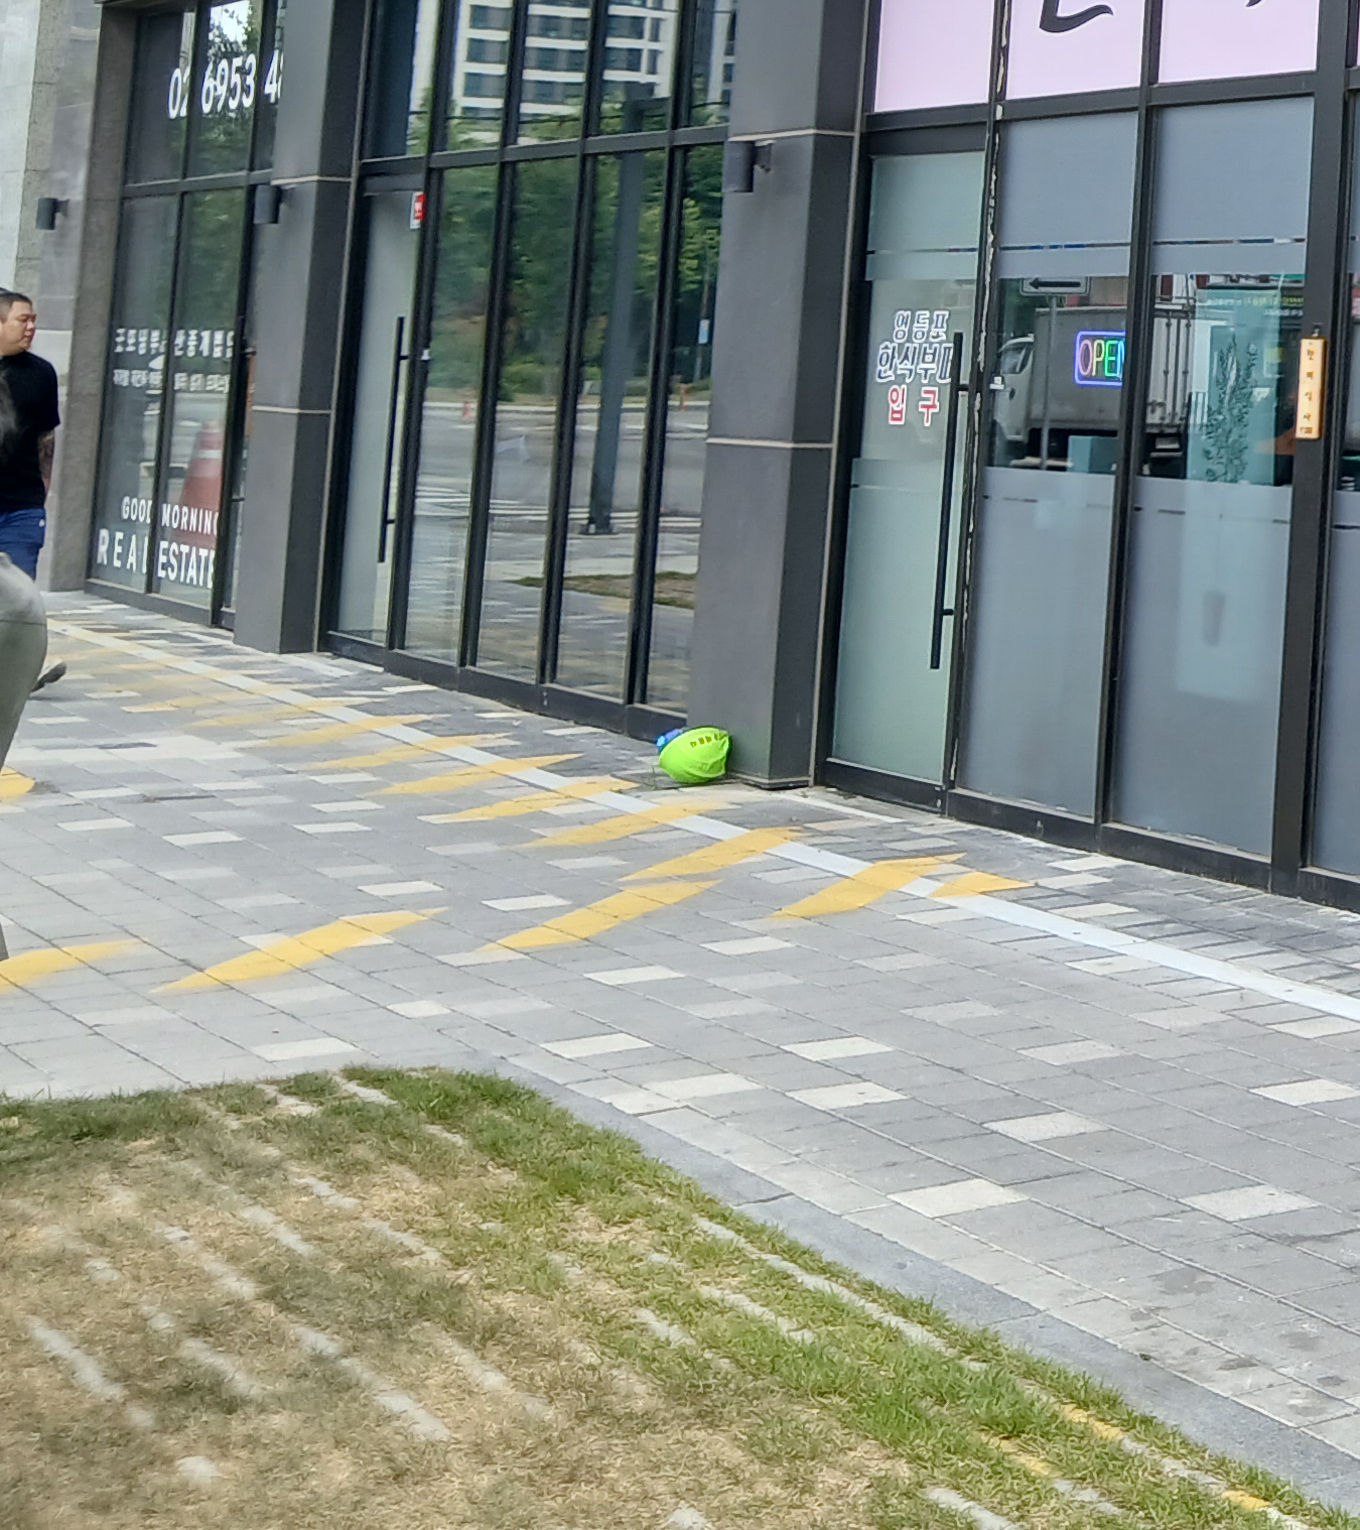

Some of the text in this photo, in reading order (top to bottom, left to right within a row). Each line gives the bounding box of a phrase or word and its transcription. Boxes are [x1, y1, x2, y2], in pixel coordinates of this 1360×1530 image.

[201, 53, 256, 114] 6953
[894, 310, 949, 342] 영등포
[1078, 338, 1125, 379] OPEN
